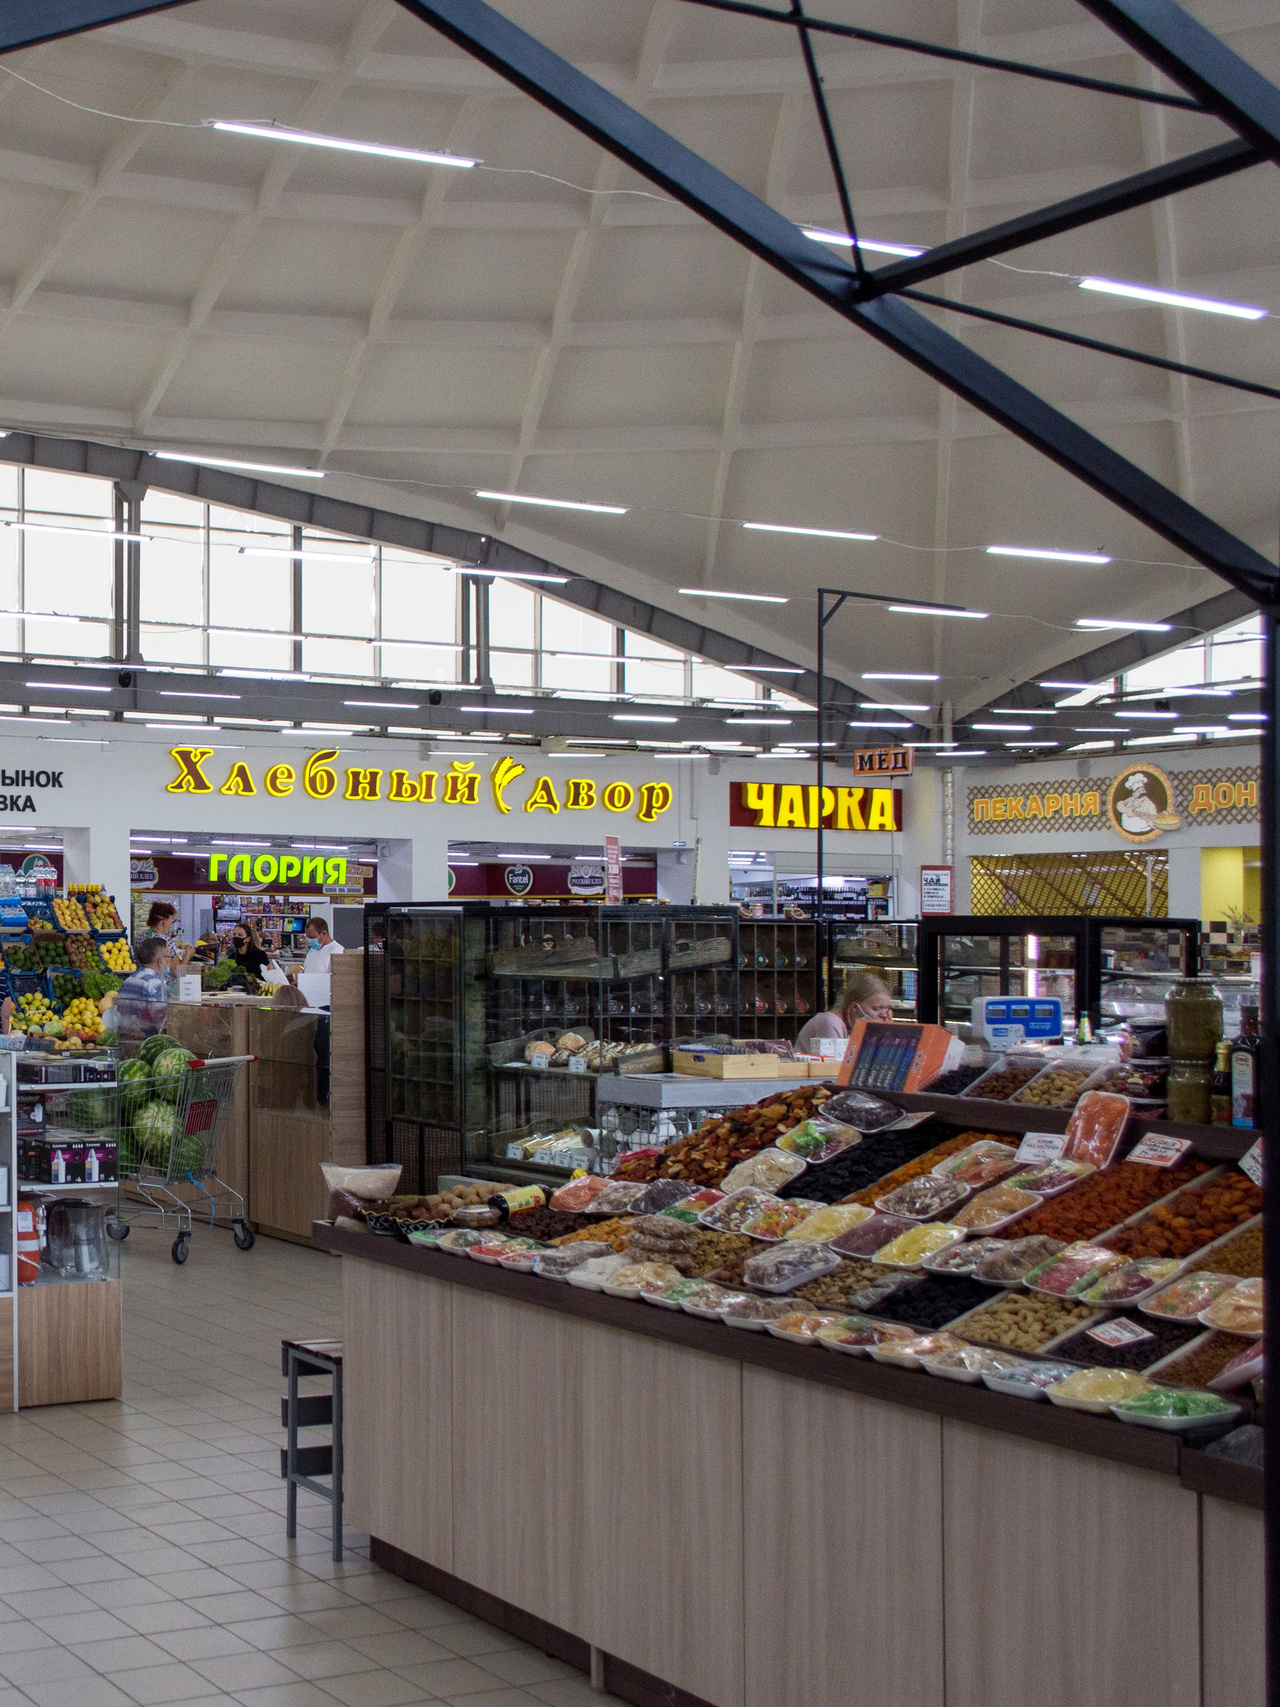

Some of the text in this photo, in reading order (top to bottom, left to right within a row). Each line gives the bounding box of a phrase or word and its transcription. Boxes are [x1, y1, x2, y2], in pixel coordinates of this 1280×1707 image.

[856, 747, 909, 773] МЁД
[166, 745, 674, 823] Хлебный двор
[742, 781, 896, 831] ЧАРКА
[972, 790, 1101, 822] ПЕКАРНЯ
[208, 852, 349, 886] ГЛОРИЯ
[507, 873, 529, 885] Fantel
[923, 875, 941, 884] ЧАЙ
